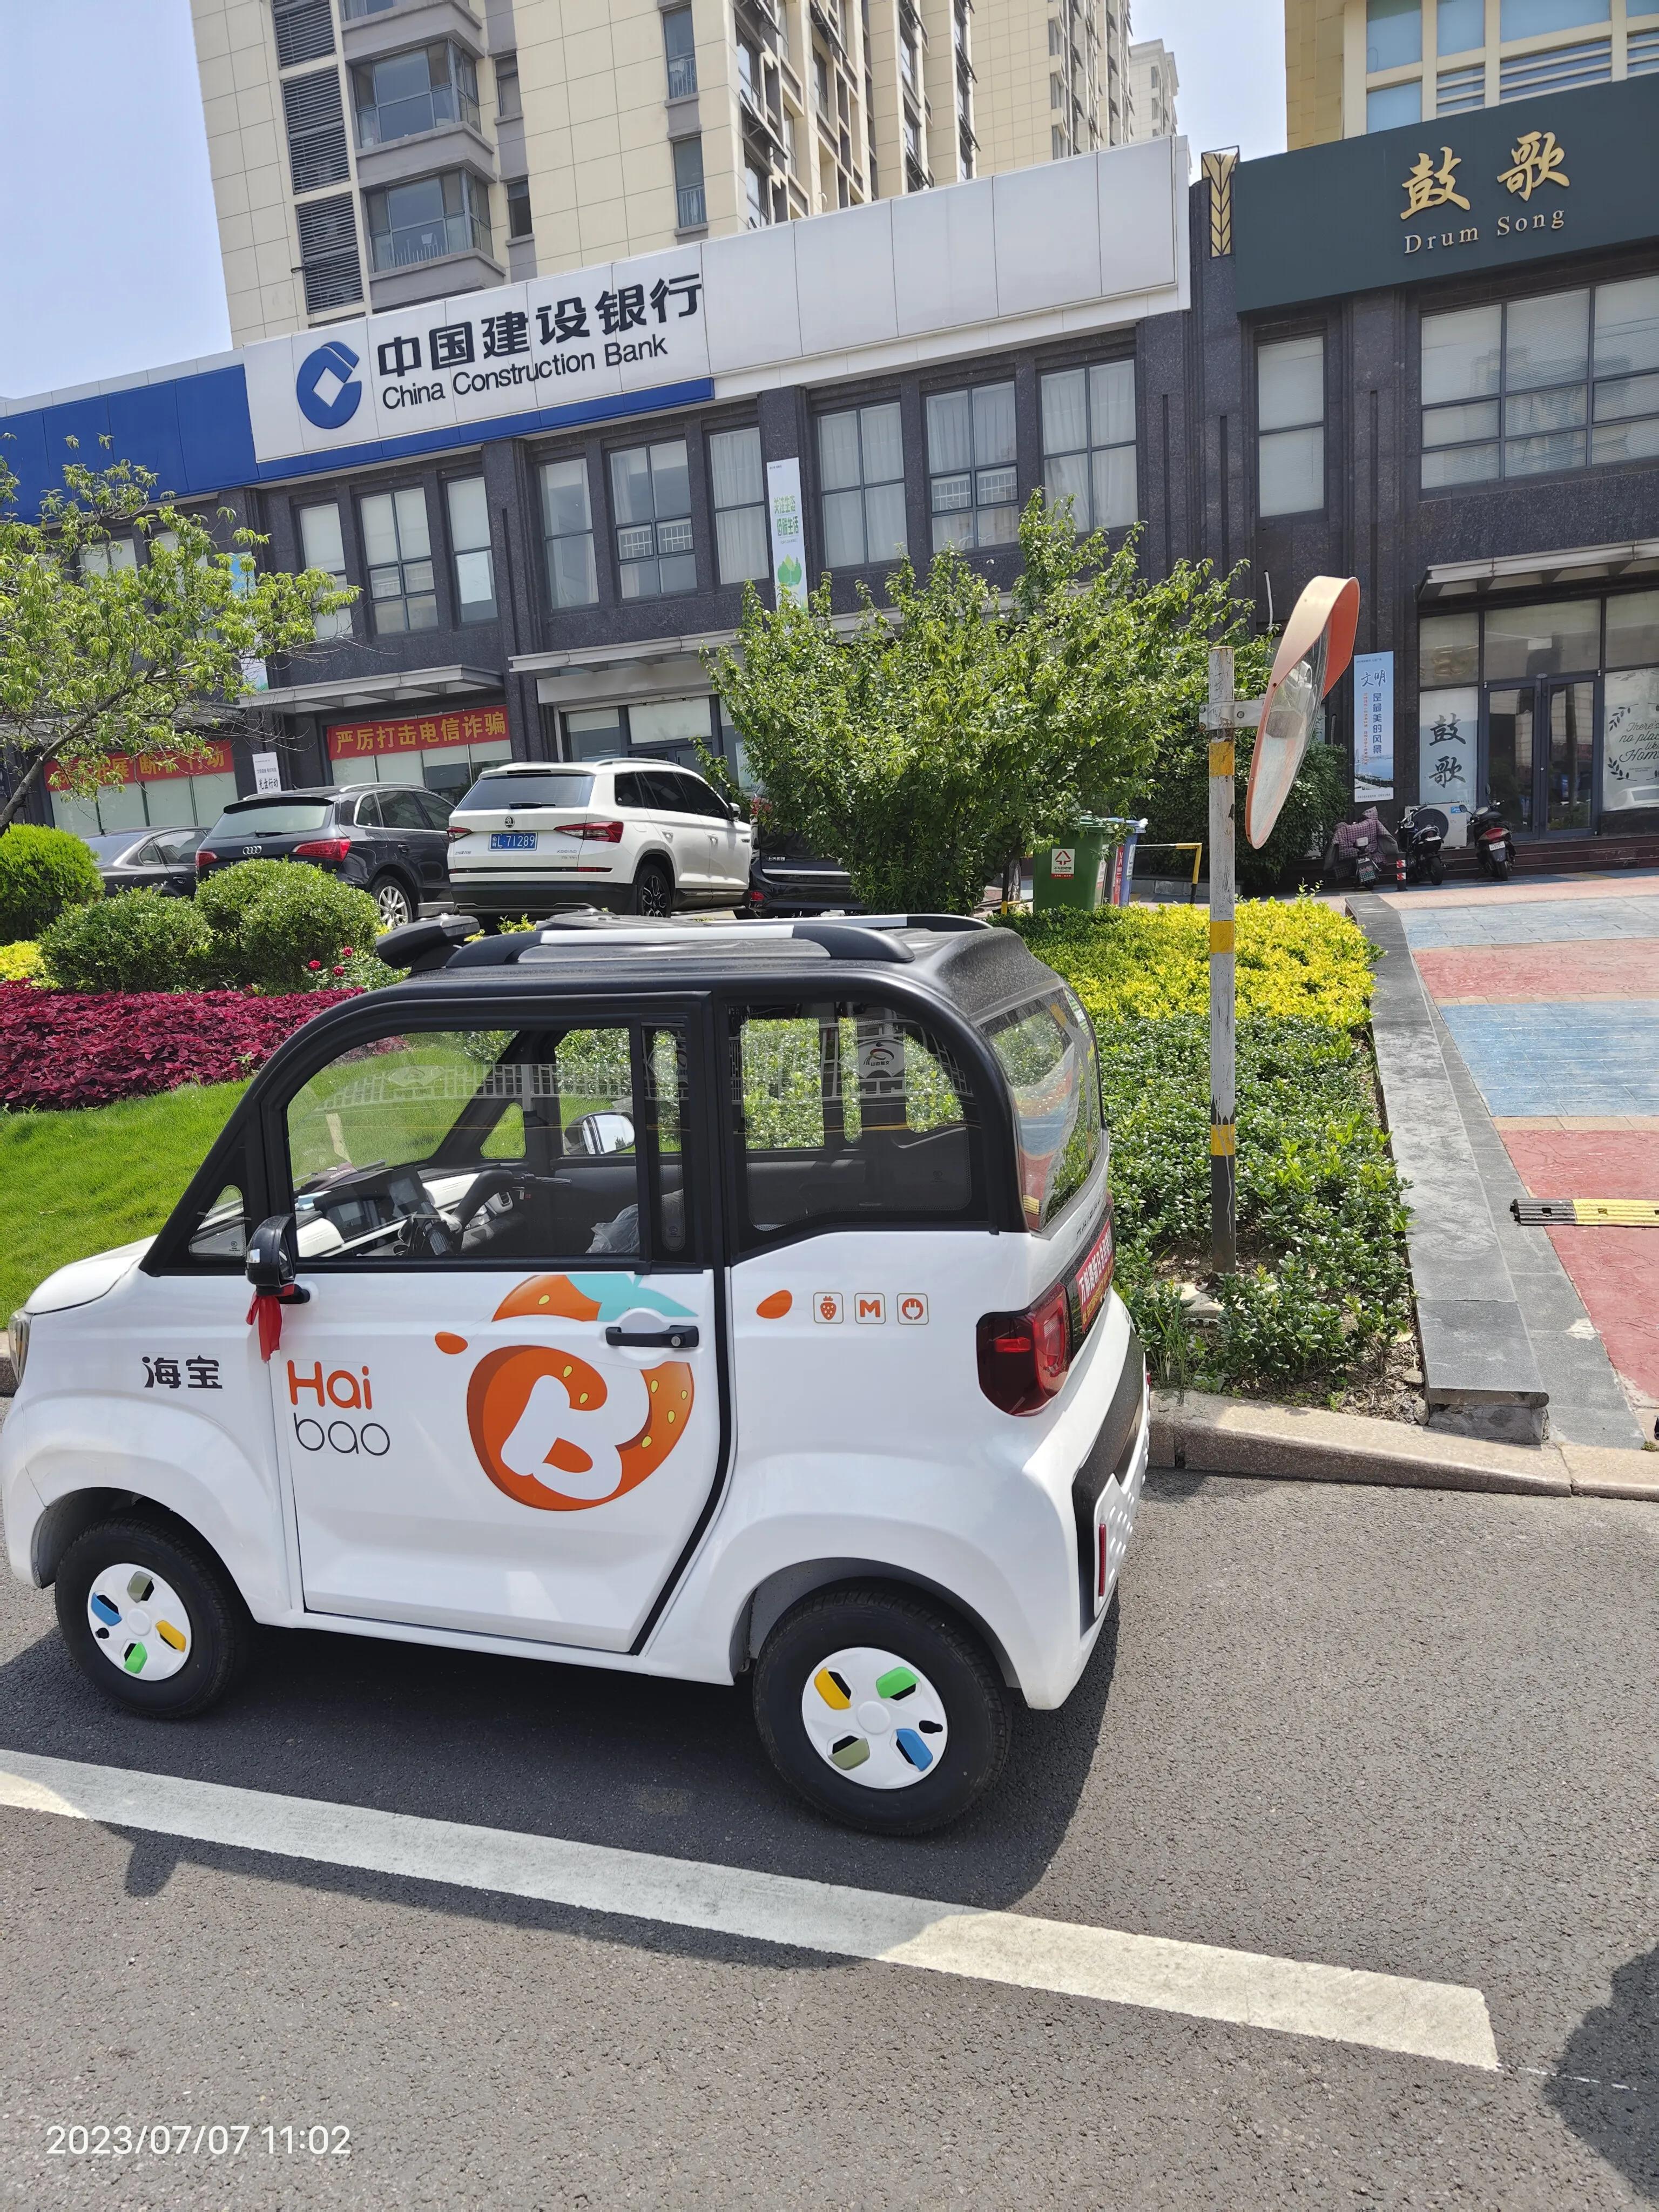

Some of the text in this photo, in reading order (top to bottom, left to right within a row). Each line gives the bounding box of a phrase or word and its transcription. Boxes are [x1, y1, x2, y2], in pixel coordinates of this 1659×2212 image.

[1400, 131, 1570, 220] 鼓歌
[1404, 210, 1566, 254] Drum Song
[378, 273, 703, 377] 中国建设银行
[382, 334, 669, 410] China Construction Bank
[1360, 669, 1387, 687] 文明
[335, 711, 506, 753] 严厉打击电信诈骗
[1372, 692, 1382, 754] 是最美的风景
[1618, 734, 1634, 743] no
[1429, 712, 1466, 788] 鼓歌
[859, 1299, 881, 1318] M
[141, 1355, 222, 1389] 海宝
[287, 1359, 373, 1410] Hai
[293, 1412, 390, 1456] bao
